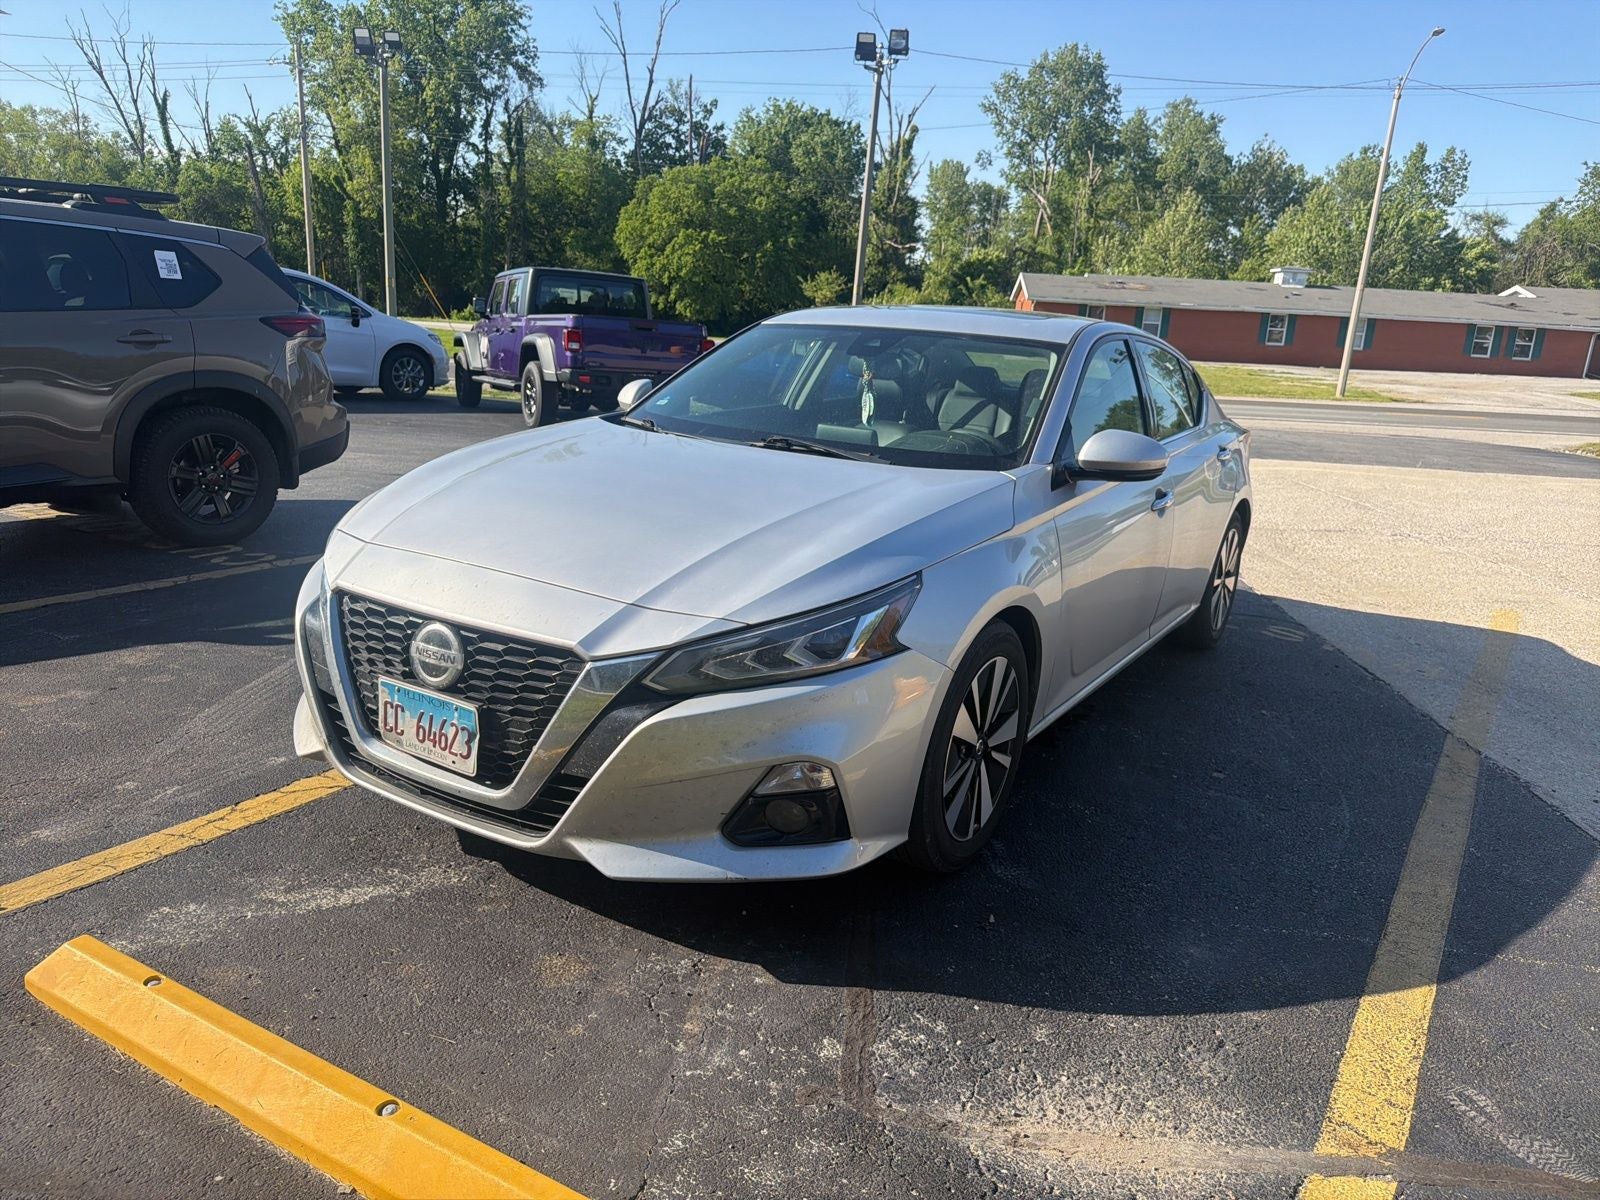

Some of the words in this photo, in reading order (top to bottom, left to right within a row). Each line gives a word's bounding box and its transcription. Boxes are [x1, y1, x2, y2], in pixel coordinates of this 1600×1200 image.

[415, 646, 456, 665] NISSAN
[404, 691, 451, 711] ILLINOIS
[383, 700, 405, 736] CC
[416, 710, 472, 760] 64623
